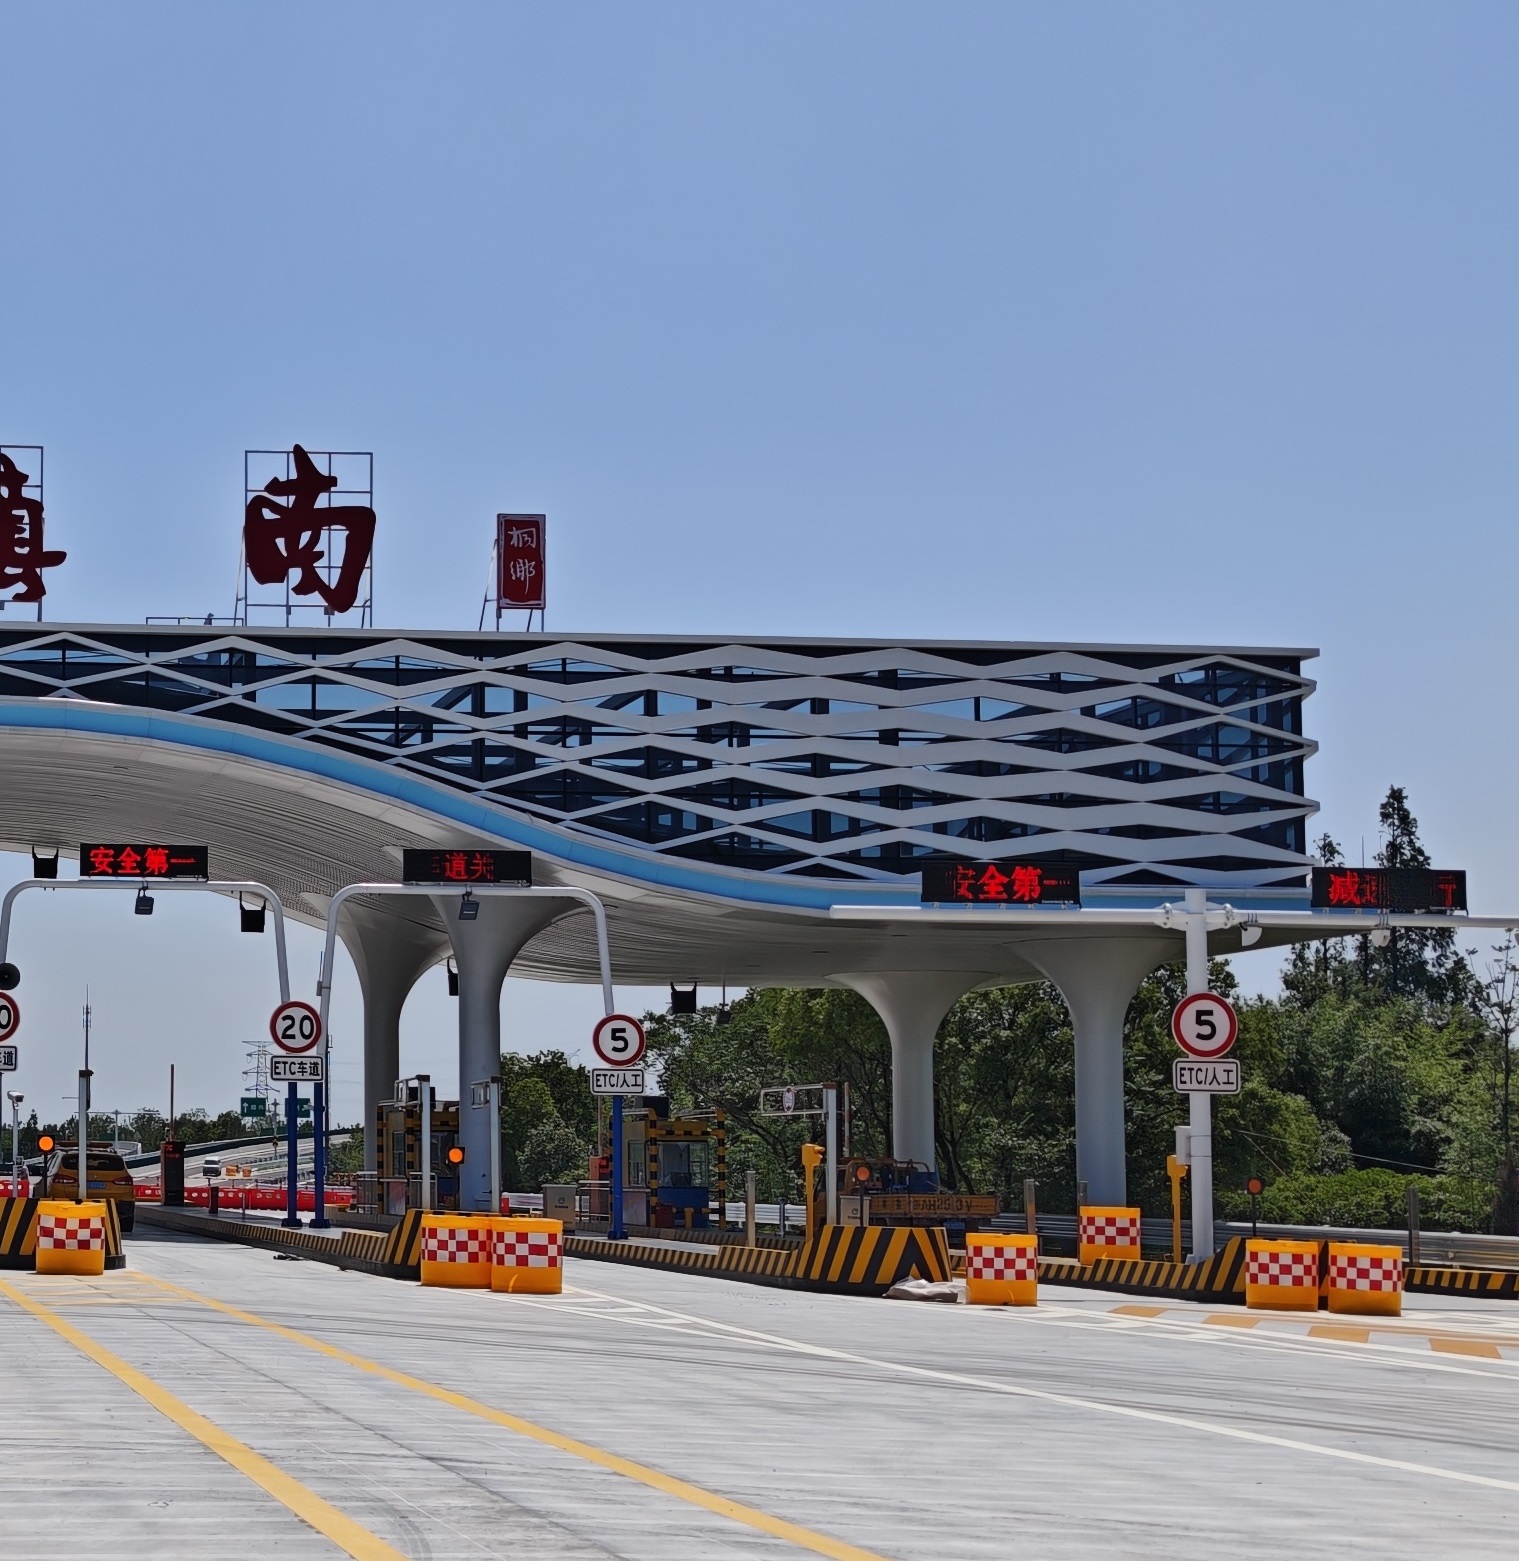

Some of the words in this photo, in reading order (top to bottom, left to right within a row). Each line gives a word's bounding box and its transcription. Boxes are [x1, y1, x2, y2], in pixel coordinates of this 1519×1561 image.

[89, 846, 197, 875] 安全第一
[281, 1014, 315, 1040] 20
[1195, 1009, 1217, 1041] 5
[610, 1027, 629, 1053] 5
[273, 1061, 320, 1076] ETC车道
[595, 1072, 641, 1088] ETC/人工
[1179, 1066, 1235, 1086] ETC/人工
